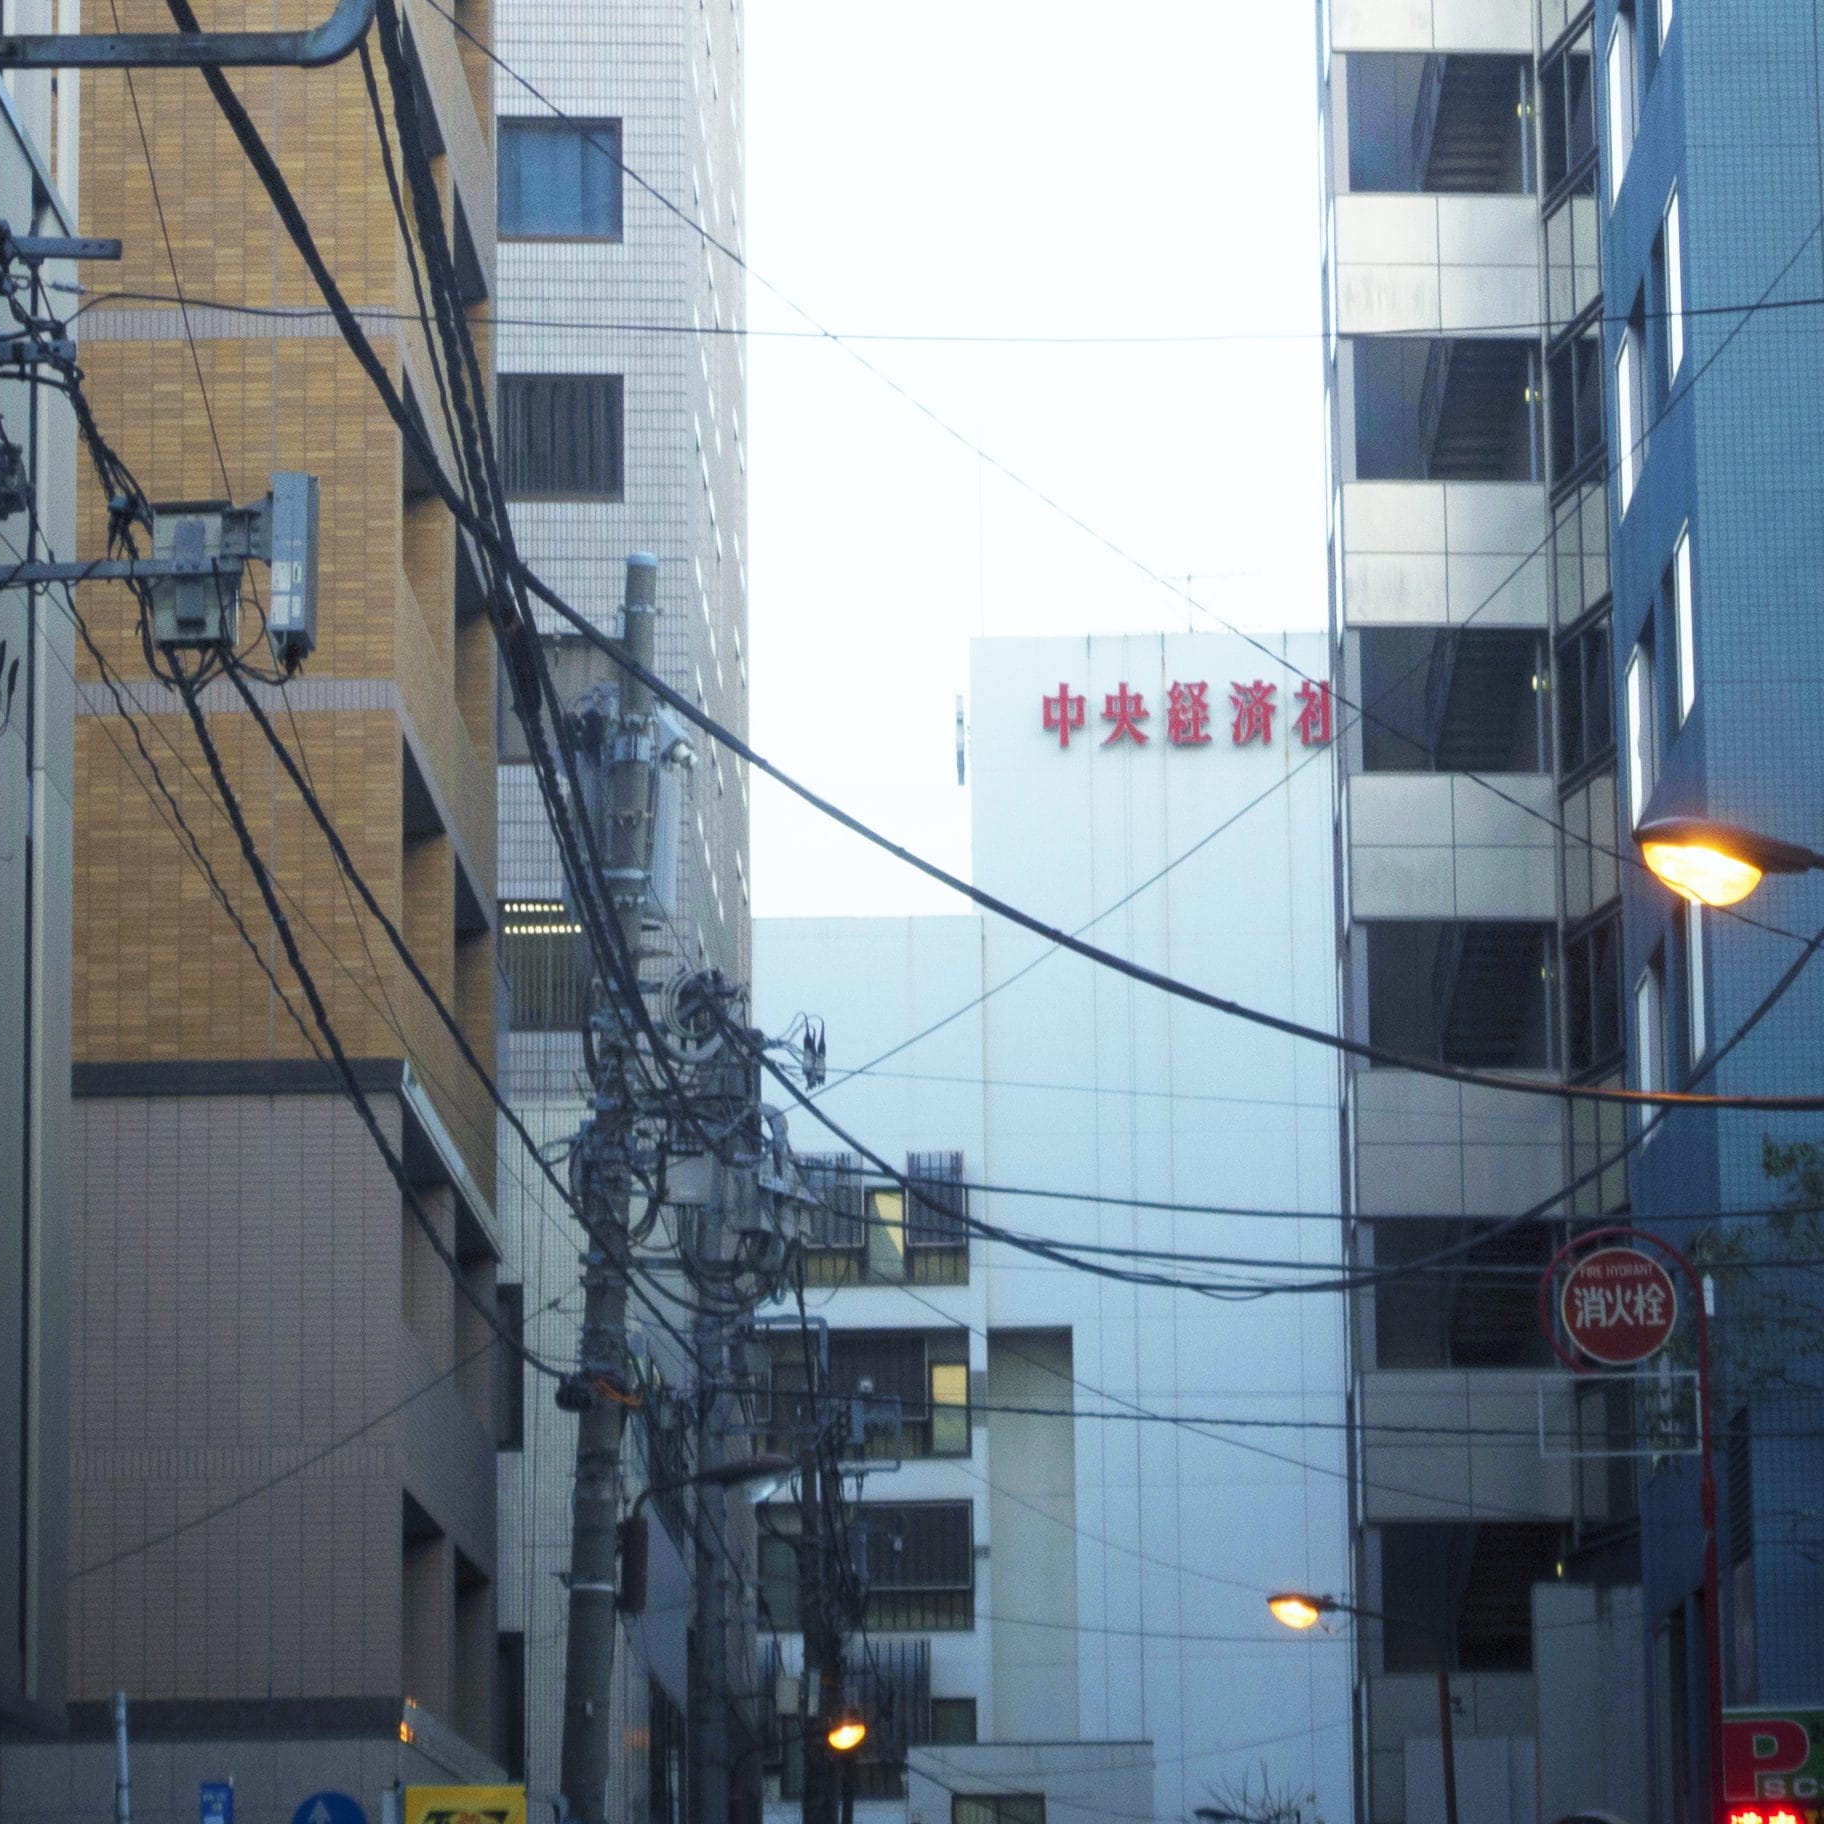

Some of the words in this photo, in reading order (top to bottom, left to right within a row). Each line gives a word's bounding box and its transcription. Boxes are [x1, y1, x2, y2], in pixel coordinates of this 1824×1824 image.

[1042, 679, 1332, 748] 中央経済社
[1579, 1264, 1603, 1279] FIRE
[1605, 1263, 1654, 1278] HYDRANT
[1573, 1282, 1666, 1329] 消火栓
